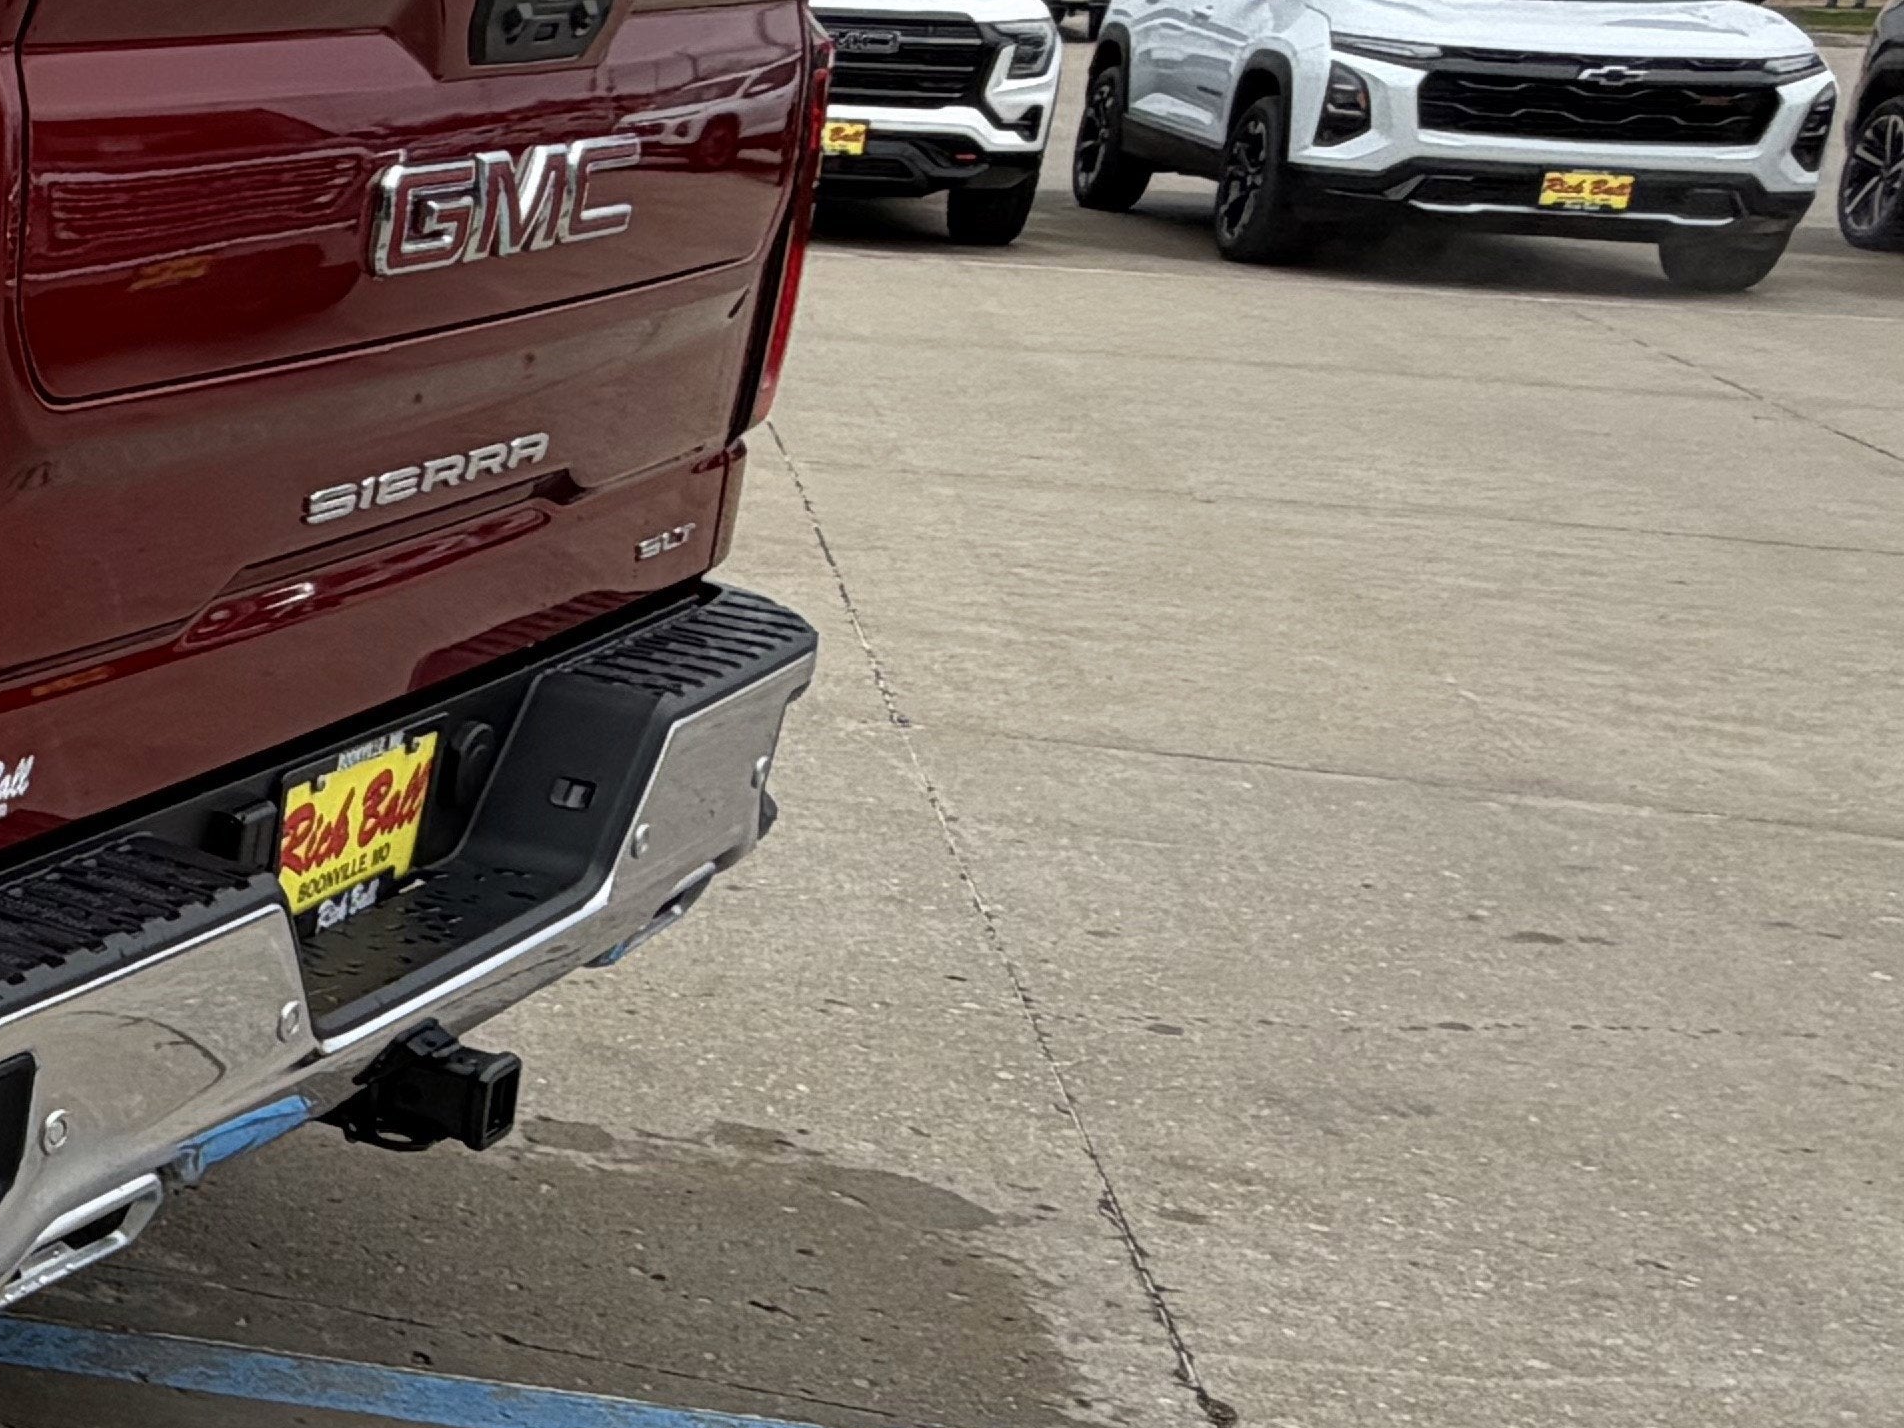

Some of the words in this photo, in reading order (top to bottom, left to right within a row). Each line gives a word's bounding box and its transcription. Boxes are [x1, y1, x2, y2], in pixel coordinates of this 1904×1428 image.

[372, 133, 641, 276] GMC
[304, 432, 550, 525] SIERRA
[635, 522, 695, 561] SLT
[281, 786, 355, 875] Rick
[358, 758, 433, 848] Ball
